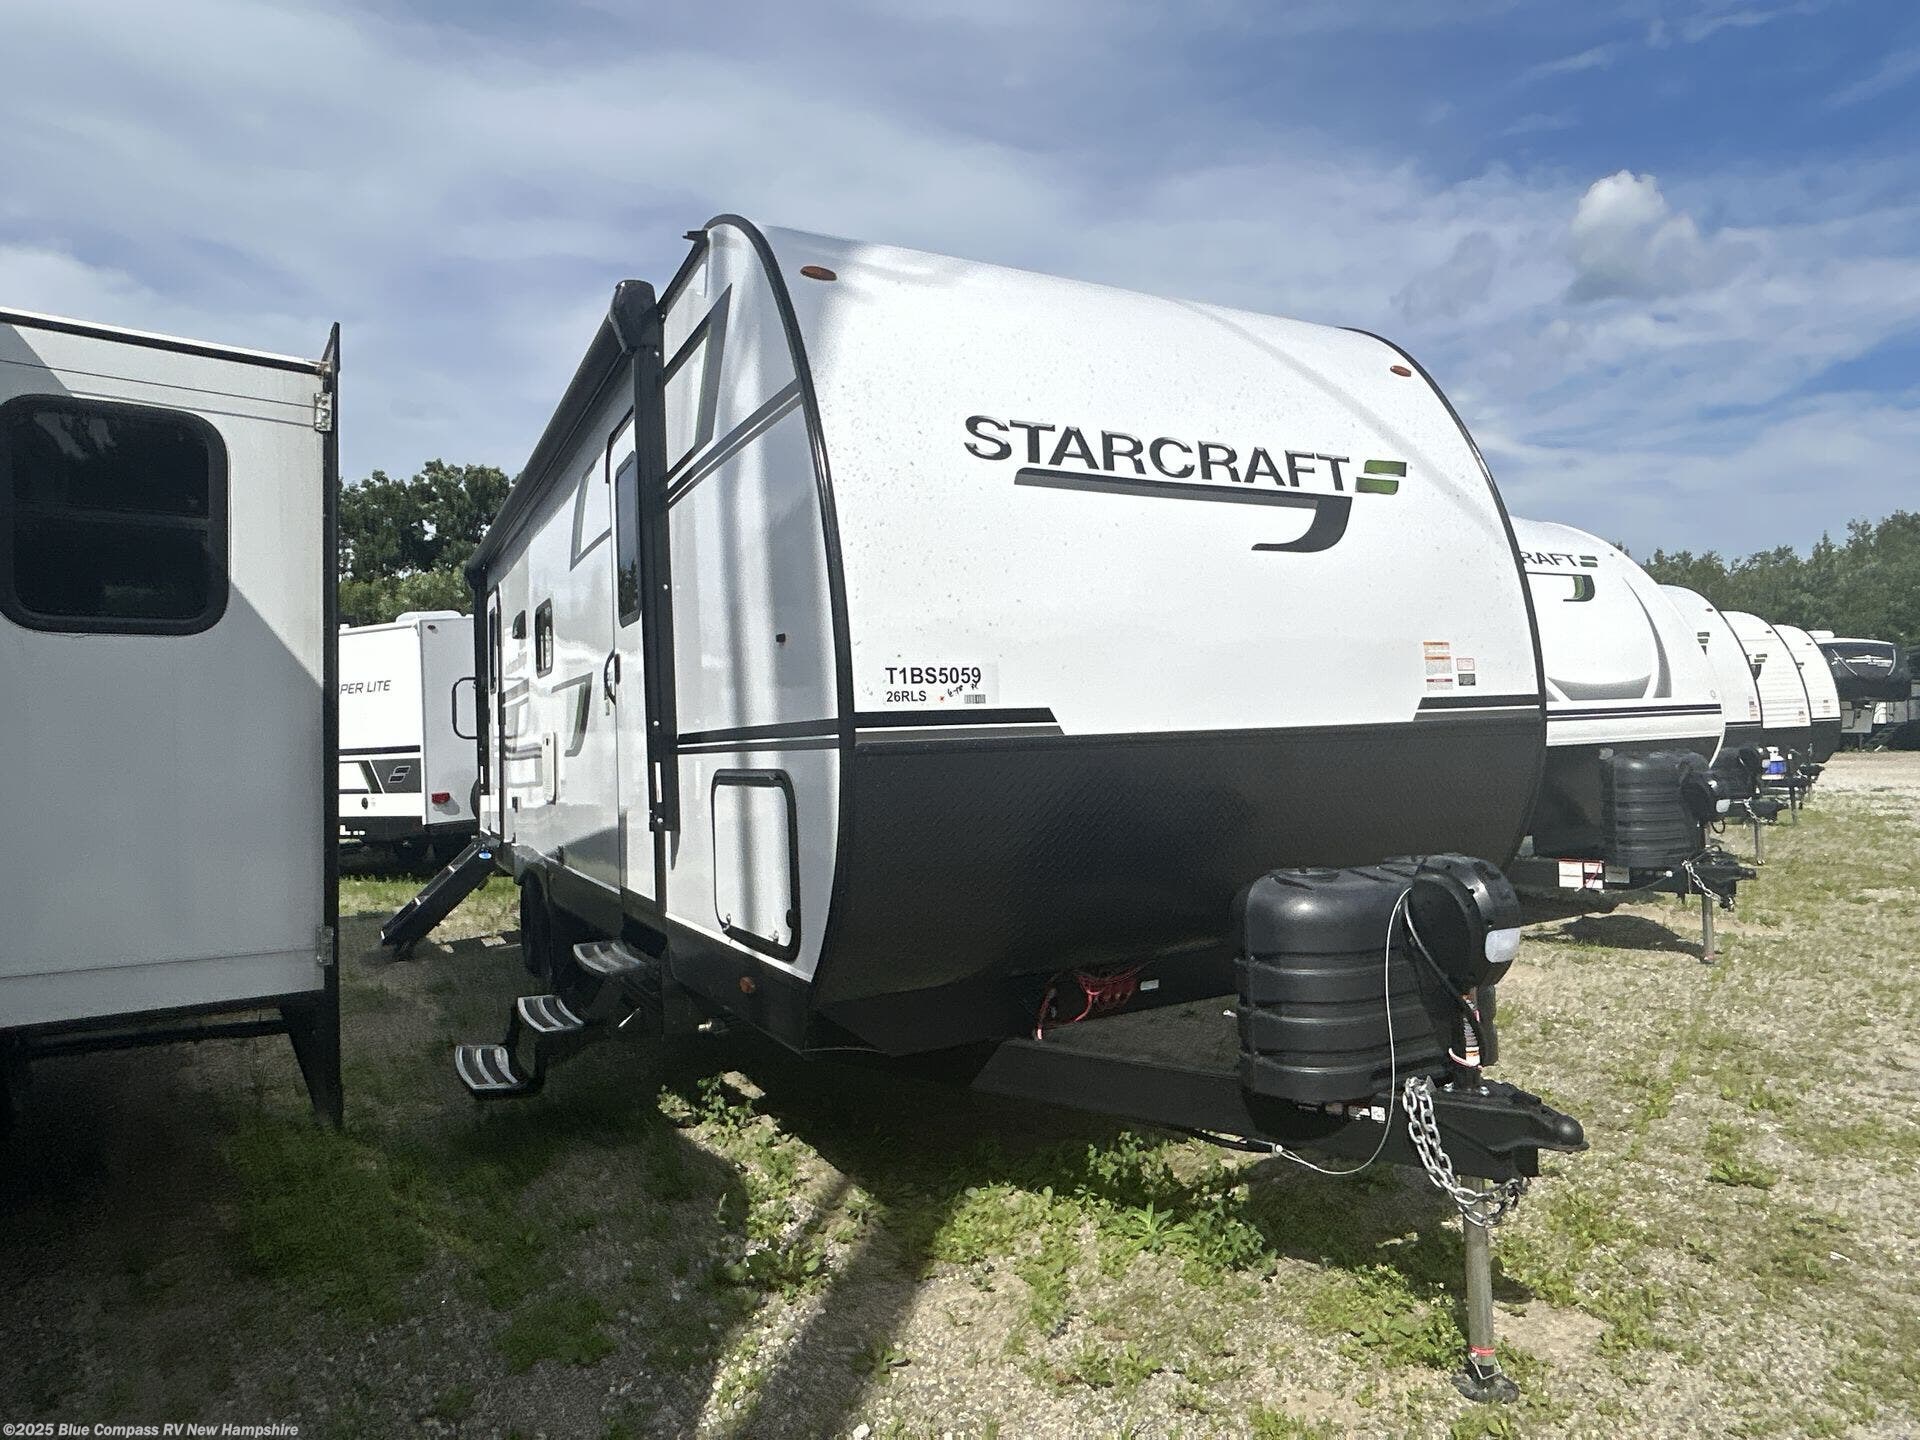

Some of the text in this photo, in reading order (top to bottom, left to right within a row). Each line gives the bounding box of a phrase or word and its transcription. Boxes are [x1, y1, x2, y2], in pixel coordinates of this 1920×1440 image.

[964, 414, 1350, 492] STARCRAFT
[885, 667, 981, 685] T1BS5059
[366, 680, 391, 693] LITE
[886, 690, 927, 702] 26RLS
